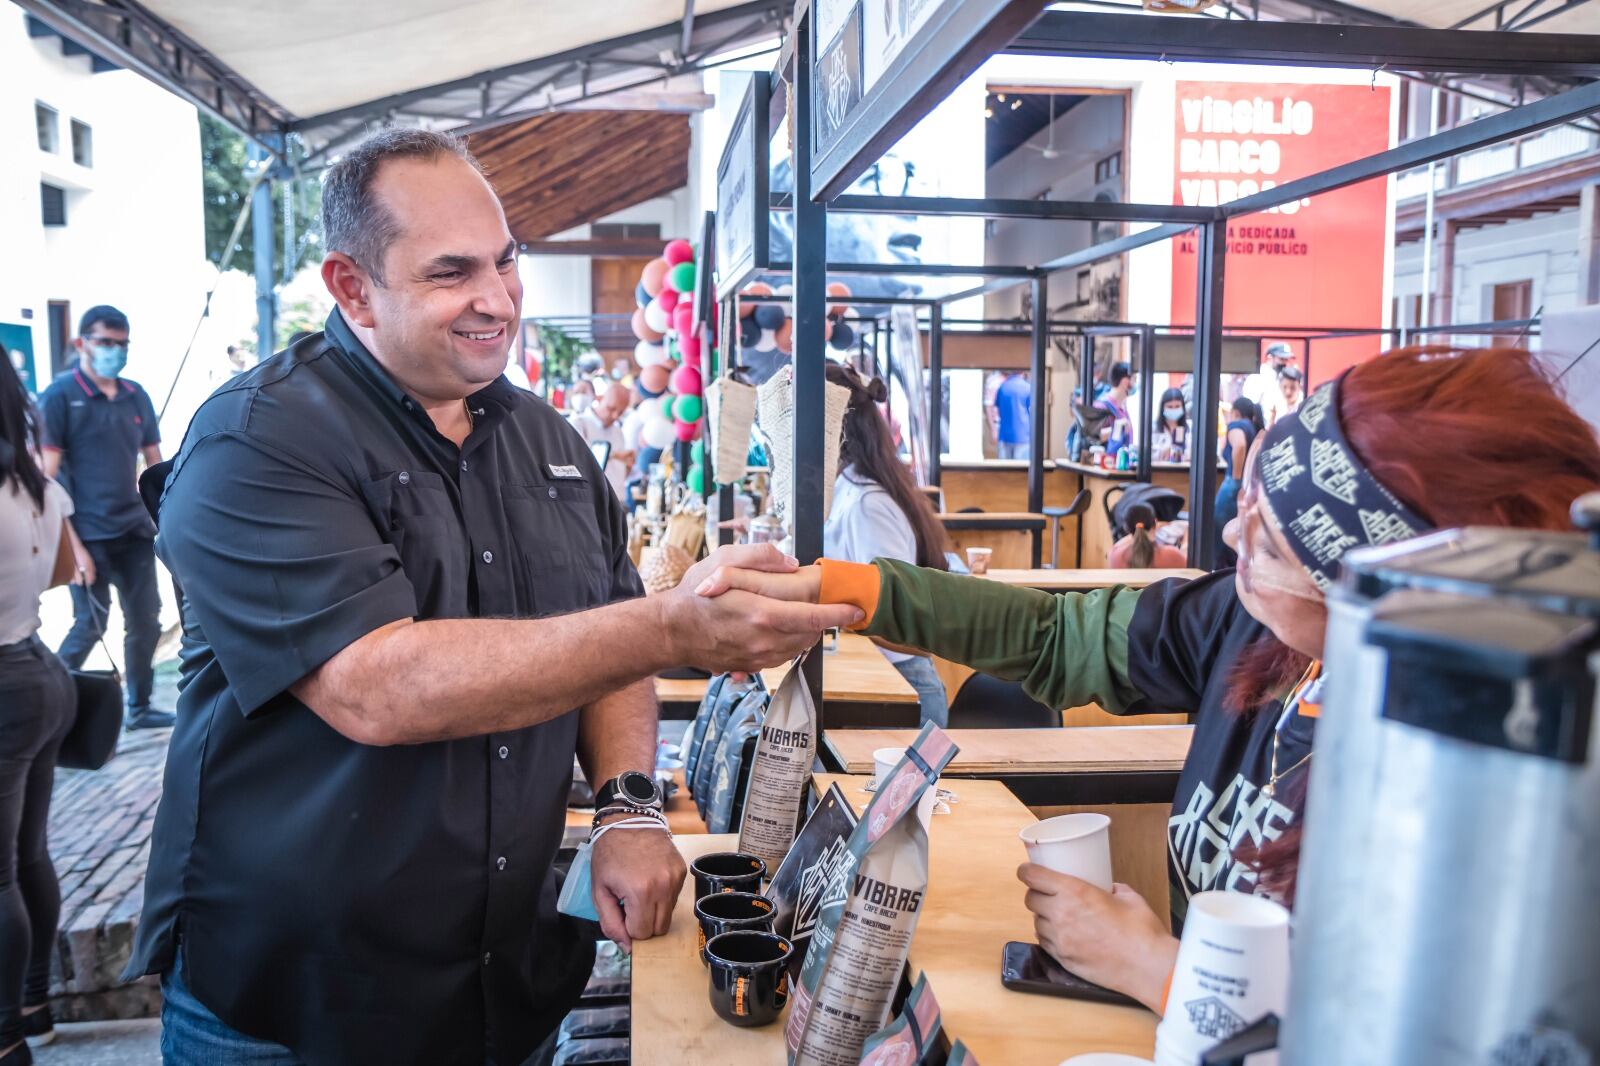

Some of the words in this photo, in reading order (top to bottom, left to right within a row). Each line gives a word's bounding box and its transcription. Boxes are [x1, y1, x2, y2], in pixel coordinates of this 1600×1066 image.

[1180, 139, 1281, 174] BARCO
[1180, 242, 1195, 254] AL
[1313, 439, 1359, 499] RACER
[762, 725, 809, 748] VIBRAS
[854, 874, 922, 912] VIBRAS
[864, 903, 878, 914] CAFE
[879, 909, 898, 919] RACER
